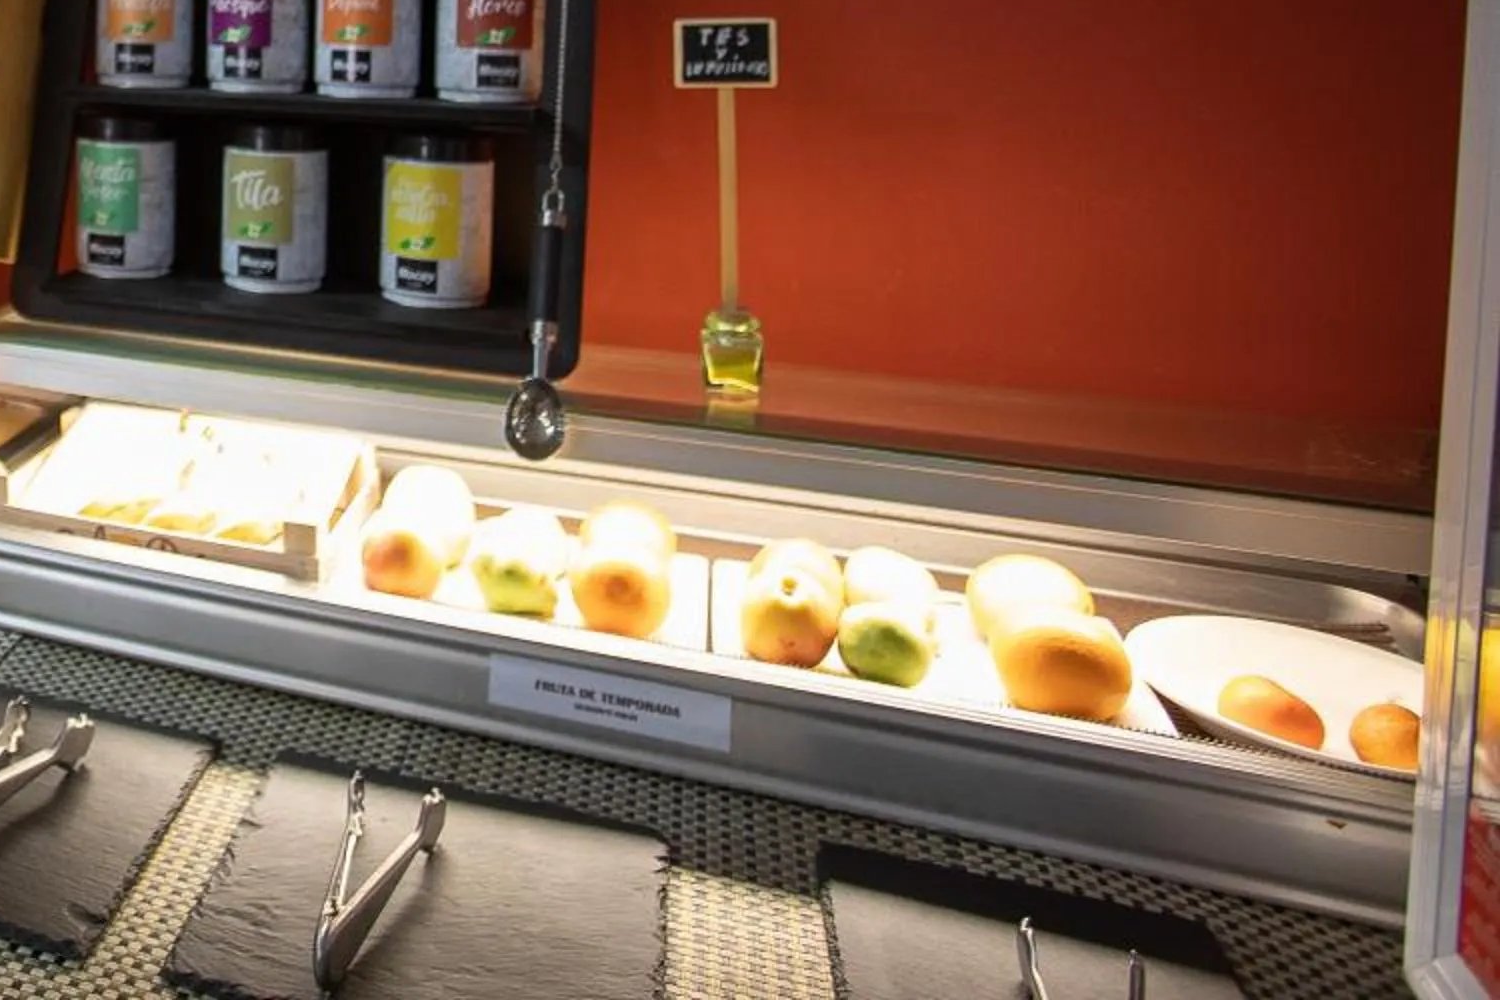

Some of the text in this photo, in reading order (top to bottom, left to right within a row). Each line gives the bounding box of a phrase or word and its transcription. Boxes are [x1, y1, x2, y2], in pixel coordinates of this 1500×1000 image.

[534, 679, 576, 697] FRUTA
[578, 688, 597, 702] DE
[600, 692, 682, 719] TEMPORADA
